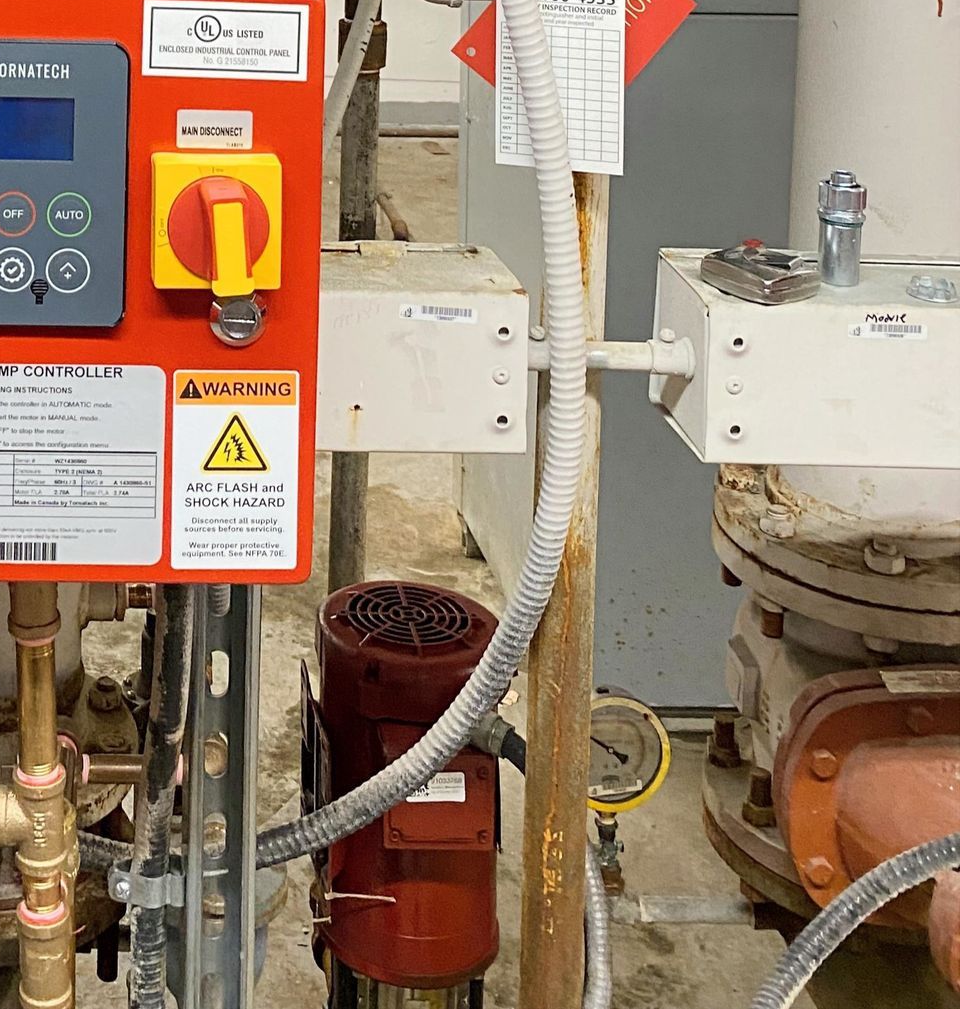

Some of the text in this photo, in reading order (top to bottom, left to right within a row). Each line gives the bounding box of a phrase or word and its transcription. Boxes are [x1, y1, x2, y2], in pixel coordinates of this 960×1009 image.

[542, 4, 617, 15] INSPECTION RECORD
[222, 29, 233, 38] US
[236, 30, 264, 39] LISTED
[159, 45, 291, 57] ENCLOSED INDUSTRIAL CONTROL PANEL
[181, 126, 243, 137] MAIN DISCONNECT
[2, 209, 24, 219] OFF
[55, 210, 84, 220] AUTO
[23, 366, 123, 378] CONTROLLER
[14, 386, 73, 394] INSTRUCTIONS
[202, 382, 292, 396] WARNING
[186, 482, 284, 493] ARC FLASH and
[184, 498, 285, 508] SHOCK HAZARD
[250, 517, 278, 526] supply
[218, 525, 244, 533] before
[246, 525, 285, 534] servicing.
[211, 542, 238, 550] proper
[240, 542, 279, 550] protective
[181, 550, 226, 558] equipment.
[245, 550, 268, 558] NFPA
